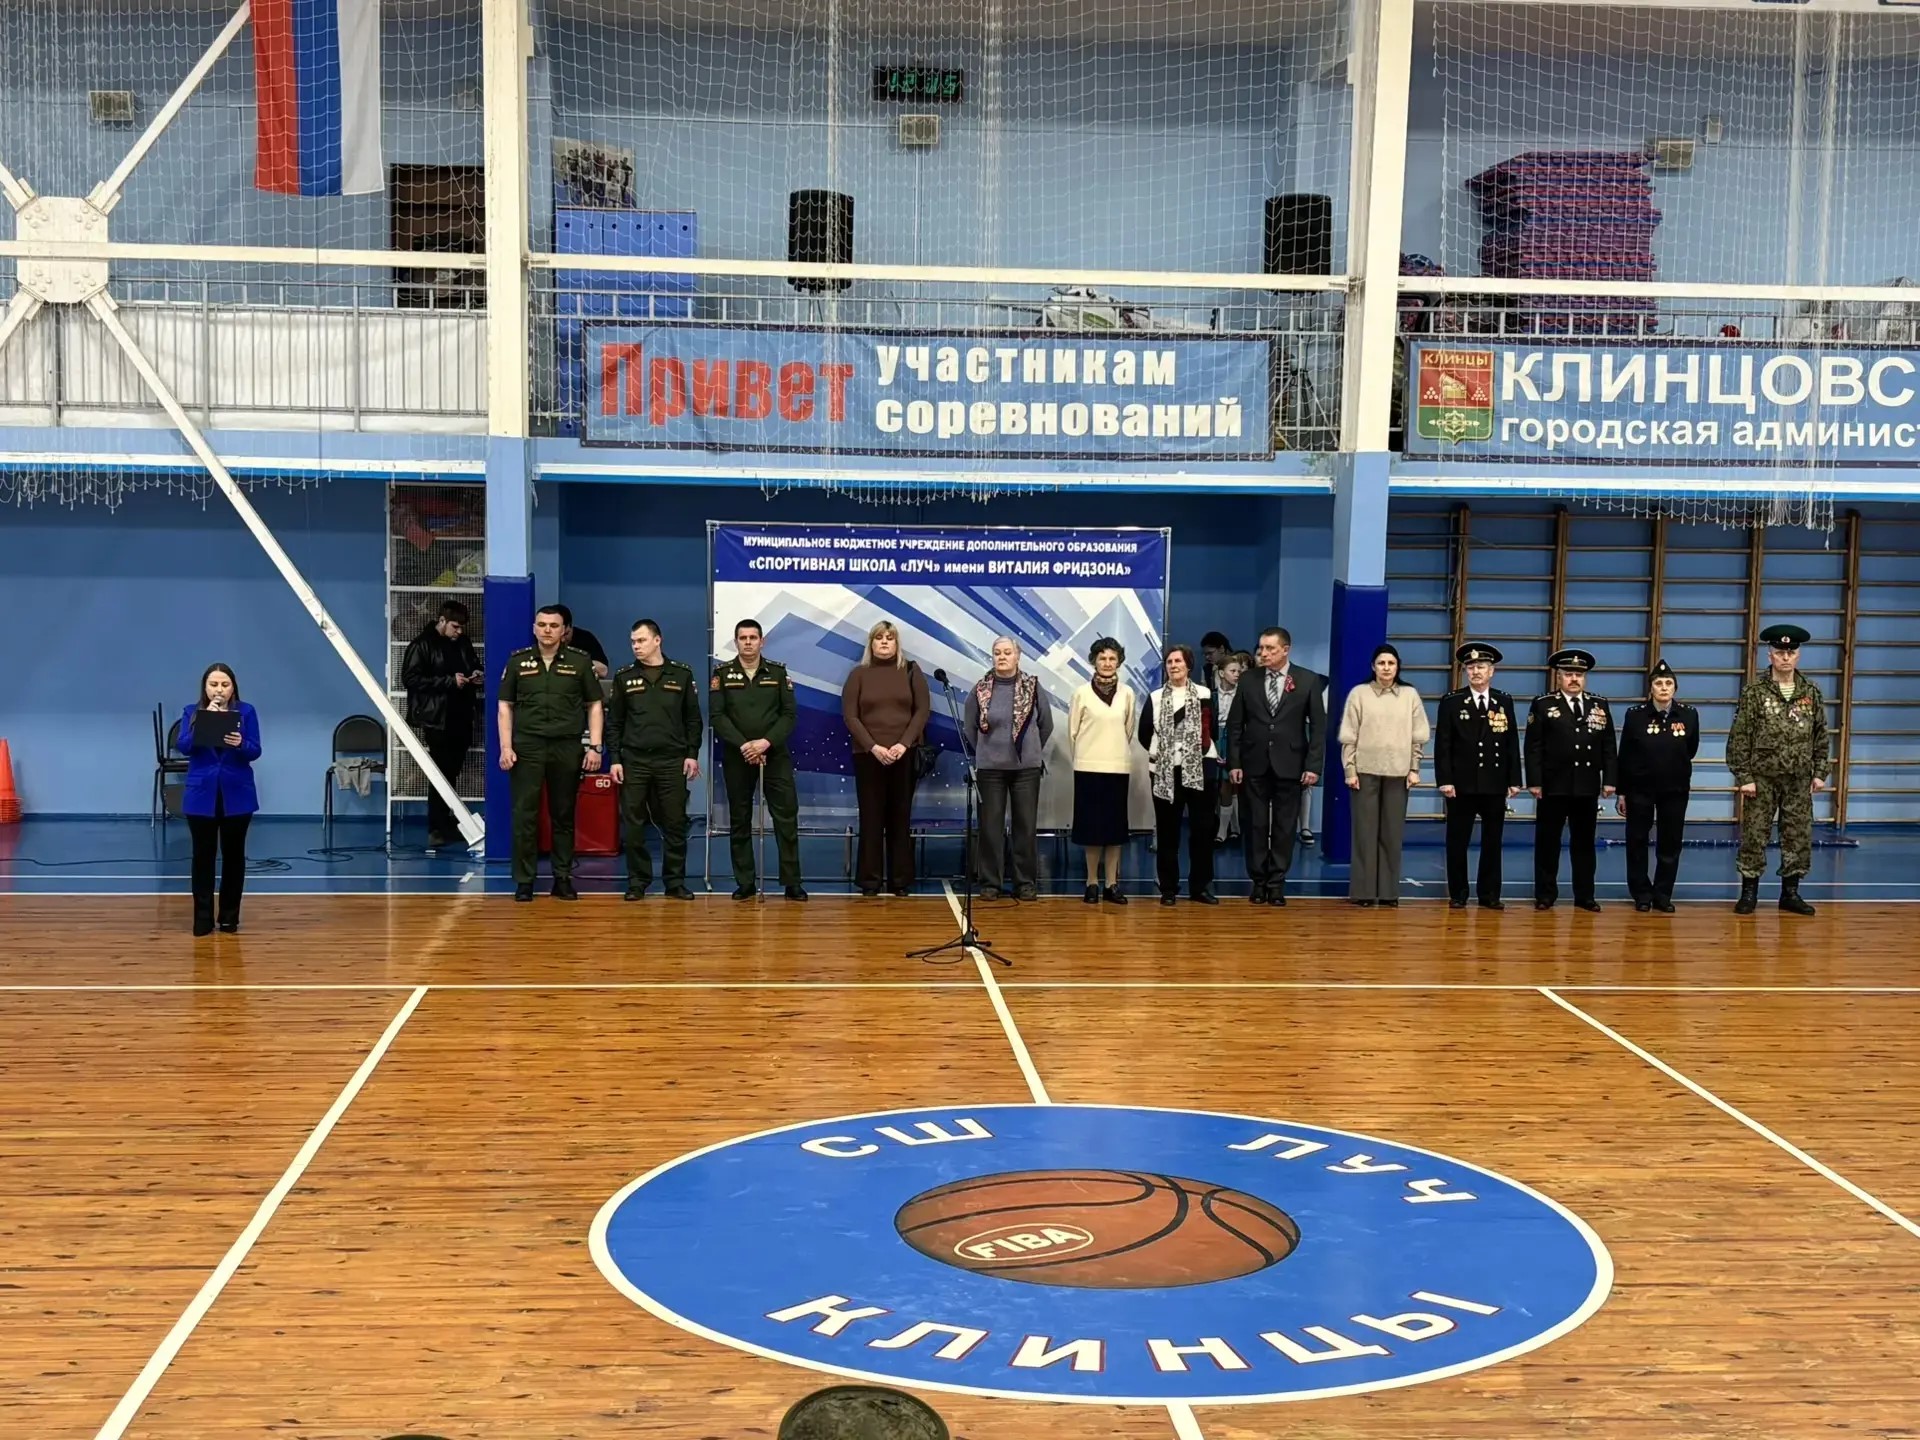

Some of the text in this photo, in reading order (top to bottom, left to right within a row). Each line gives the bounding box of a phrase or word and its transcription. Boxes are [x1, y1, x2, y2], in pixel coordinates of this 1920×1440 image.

[876, 345, 1176, 386] участникам
[1424, 352, 1488, 367] КЛИНЦЫ
[601, 341, 854, 427] Привет
[1502, 352, 1916, 414] КЛИНЦОВС
[875, 397, 1242, 439] соревнований
[1502, 418, 1920, 452] городская админис
[743, 536, 1138, 553] МУНИЦИПАЛЬНОЕ БЮДЖЕТНОЕ УЧРЕЖДЕНИЕ ДОПОЛНИТЕЛЬНОГО ОБРАЗОВАНИЯ
[748, 556, 1132, 577] «СПОРТИВНАЯ ШКОЛА «ЛУЧ» имени ВИТАЛИЯ ФРИДЗОНА»
[595, 778, 611, 788] 60
[800, 1117, 1480, 1204] СШ ЛУЧ
[965, 1227, 1088, 1259] FIBA
[763, 1290, 1505, 1373] КЛИНЦЫ
